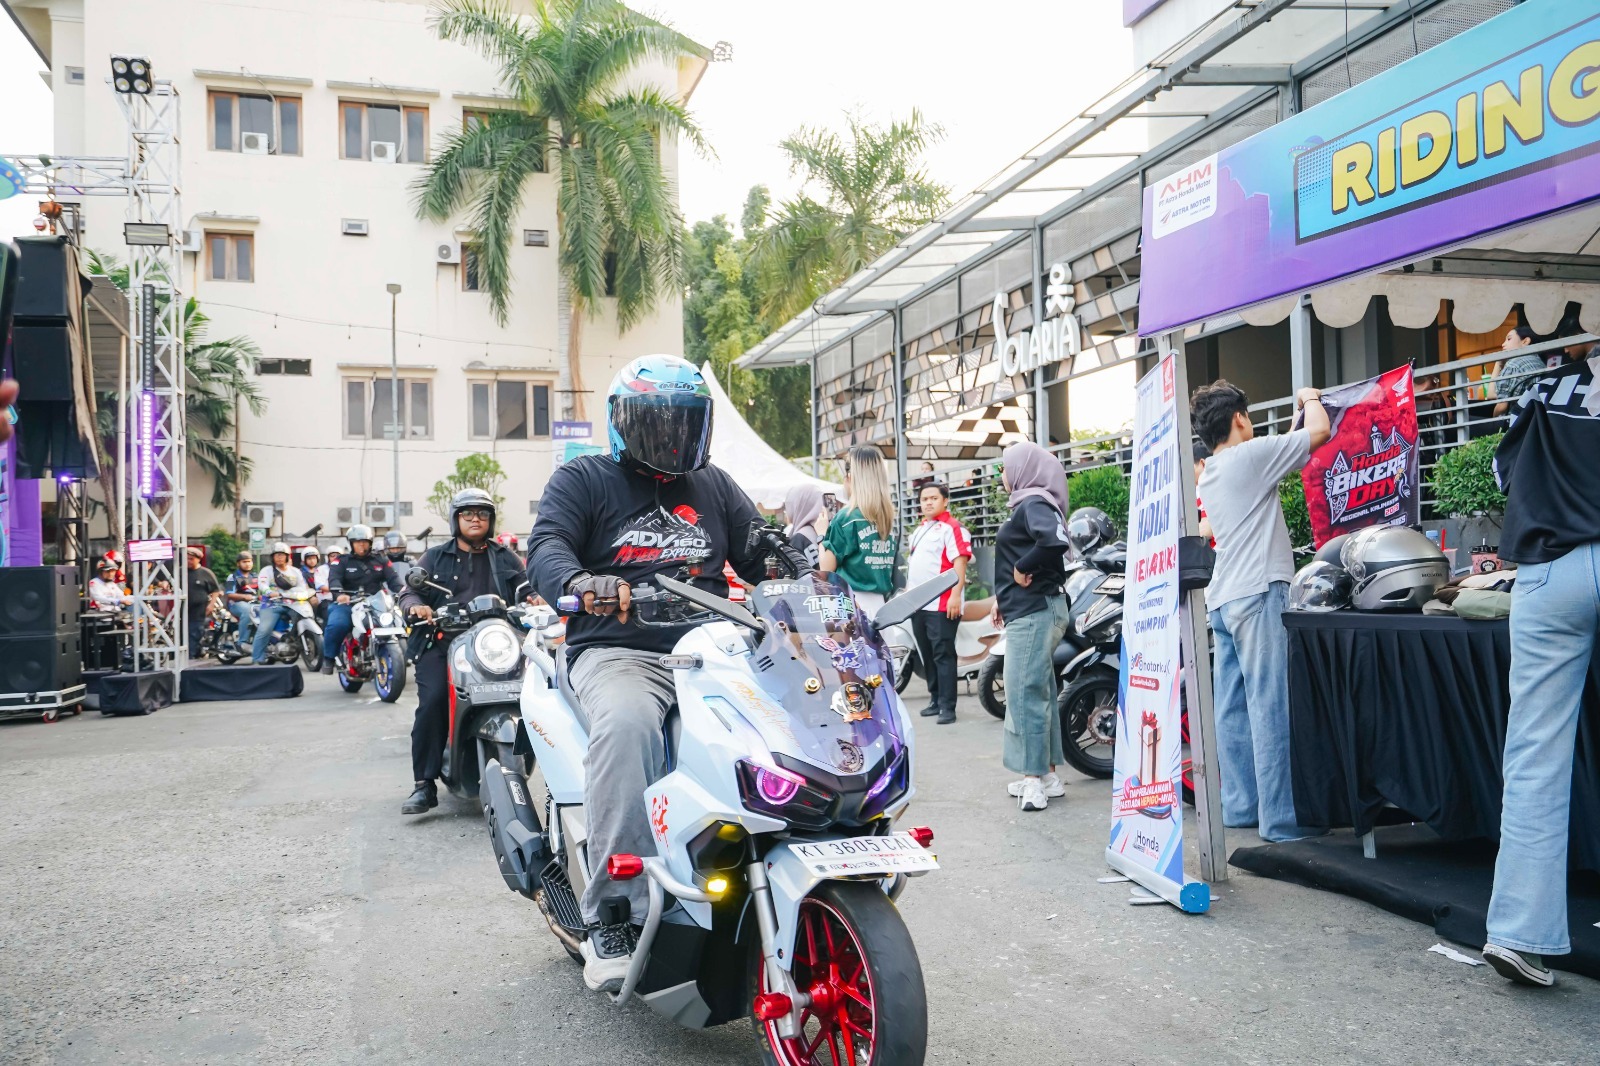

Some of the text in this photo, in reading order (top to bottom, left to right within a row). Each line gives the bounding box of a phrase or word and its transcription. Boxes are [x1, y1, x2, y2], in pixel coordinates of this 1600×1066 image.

[1331, 39, 1600, 215] RIDING
[1160, 163, 1211, 199] AHM
[1165, 195, 1178, 204] Astra
[1178, 186, 1194, 198] Honda
[1195, 179, 1212, 190] Motor
[1172, 206, 1189, 218] ASTRA
[1190, 196, 1211, 210] MOTOR
[1351, 444, 1401, 473] Honda
[1332, 453, 1407, 496] BIKERS
[1347, 476, 1396, 511] DAY
[611, 530, 706, 548] ADV 160
[763, 583, 813, 598] SATSET
[798, 836, 918, 858] KT 3605 CAL
[1136, 829, 1160, 852] Honda
